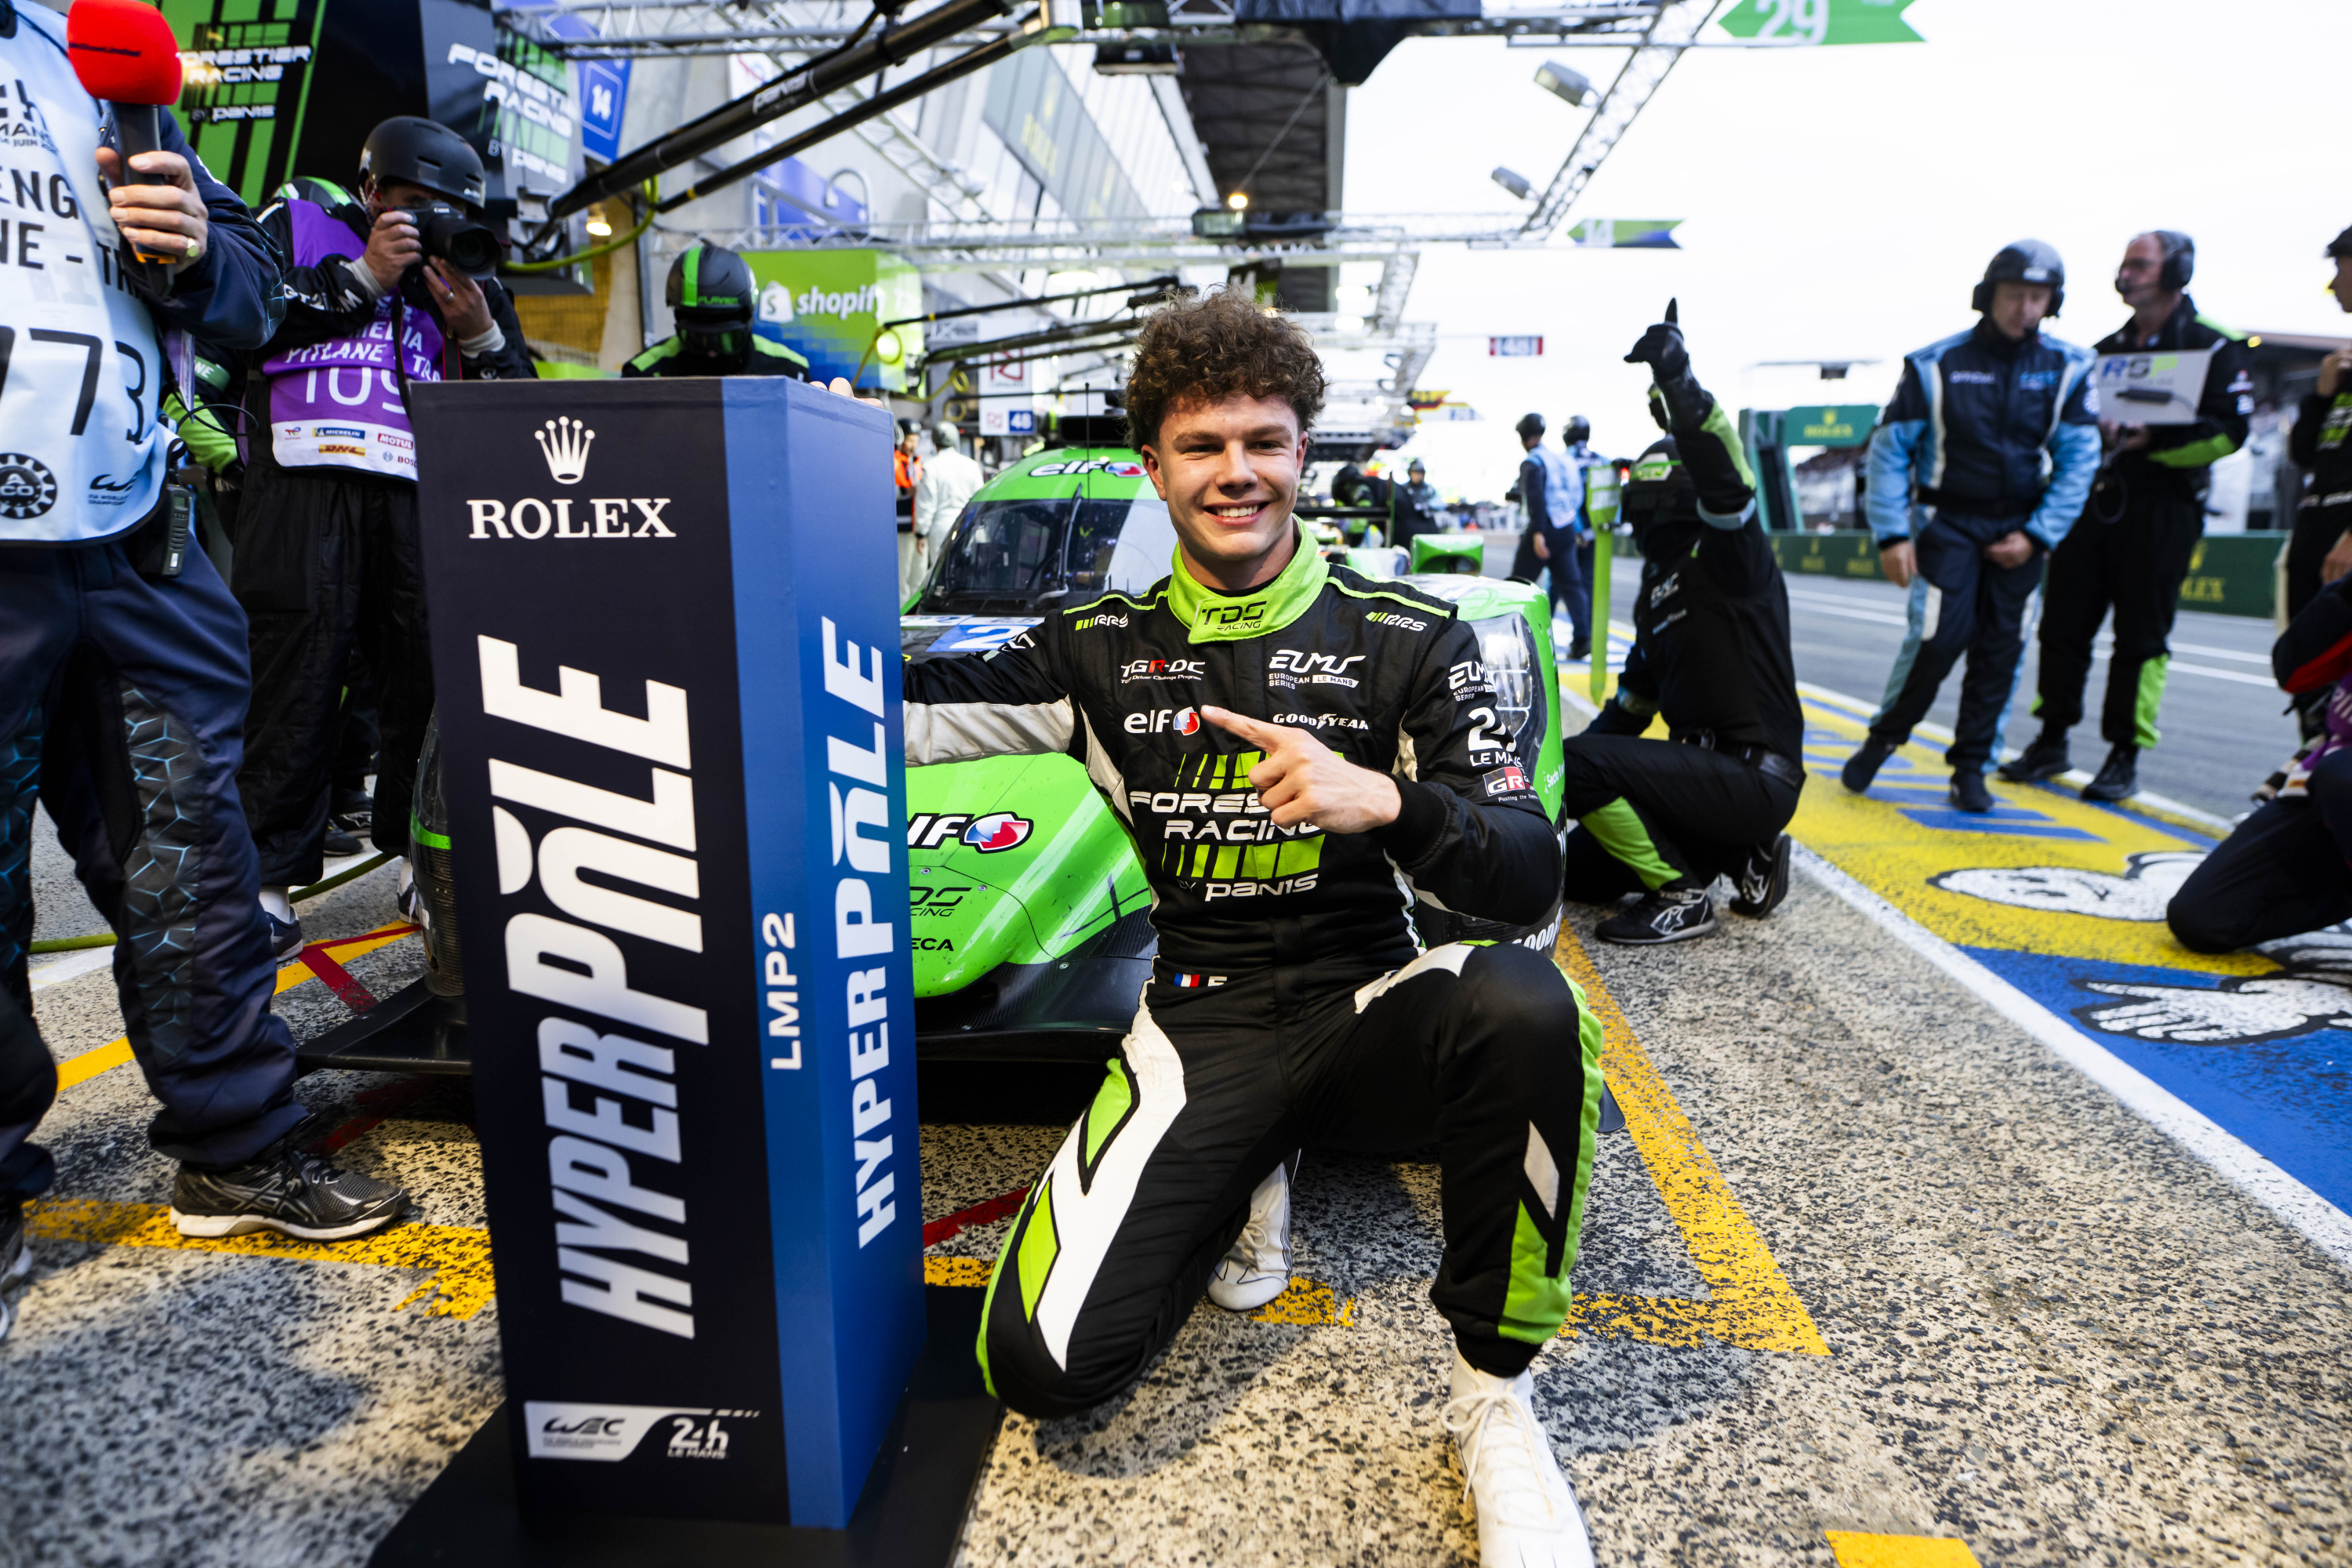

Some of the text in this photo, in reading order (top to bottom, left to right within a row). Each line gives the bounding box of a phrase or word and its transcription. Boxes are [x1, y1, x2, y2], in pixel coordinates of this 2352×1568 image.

[1755, 0, 1829, 45] 29
[176, 45, 311, 66] ORESTIER
[188, 64, 283, 85] RACING
[484, 80, 572, 138] RACING
[592, 84, 612, 121] 14
[797, 285, 887, 319] shopify
[379, 435, 412, 449] MOTUL
[397, 456, 417, 469] BOSC
[1029, 461, 1105, 477] elf
[466, 498, 677, 539] ROLEX
[1201, 601, 1267, 626] TDS
[1382, 614, 1428, 632] RRS
[1217, 620, 1262, 632] RACING
[1120, 659, 1206, 677] TGR-DC
[1269, 673, 1310, 684] EUROPEAN
[1330, 677, 1353, 686] MANS
[1269, 680, 1295, 690] SERIES
[1123, 709, 1173, 734] elf
[1469, 753, 1492, 768] LE
[1487, 775, 1524, 795] GR
[1129, 791, 1271, 814] FORES
[907, 815, 967, 846] lf
[910, 886, 973, 907] DS
[910, 907, 955, 917] CING
[912, 937, 954, 952] ECA
[761, 912, 804, 1072] LMP2
[667, 1447, 727, 1460] LE MANS
